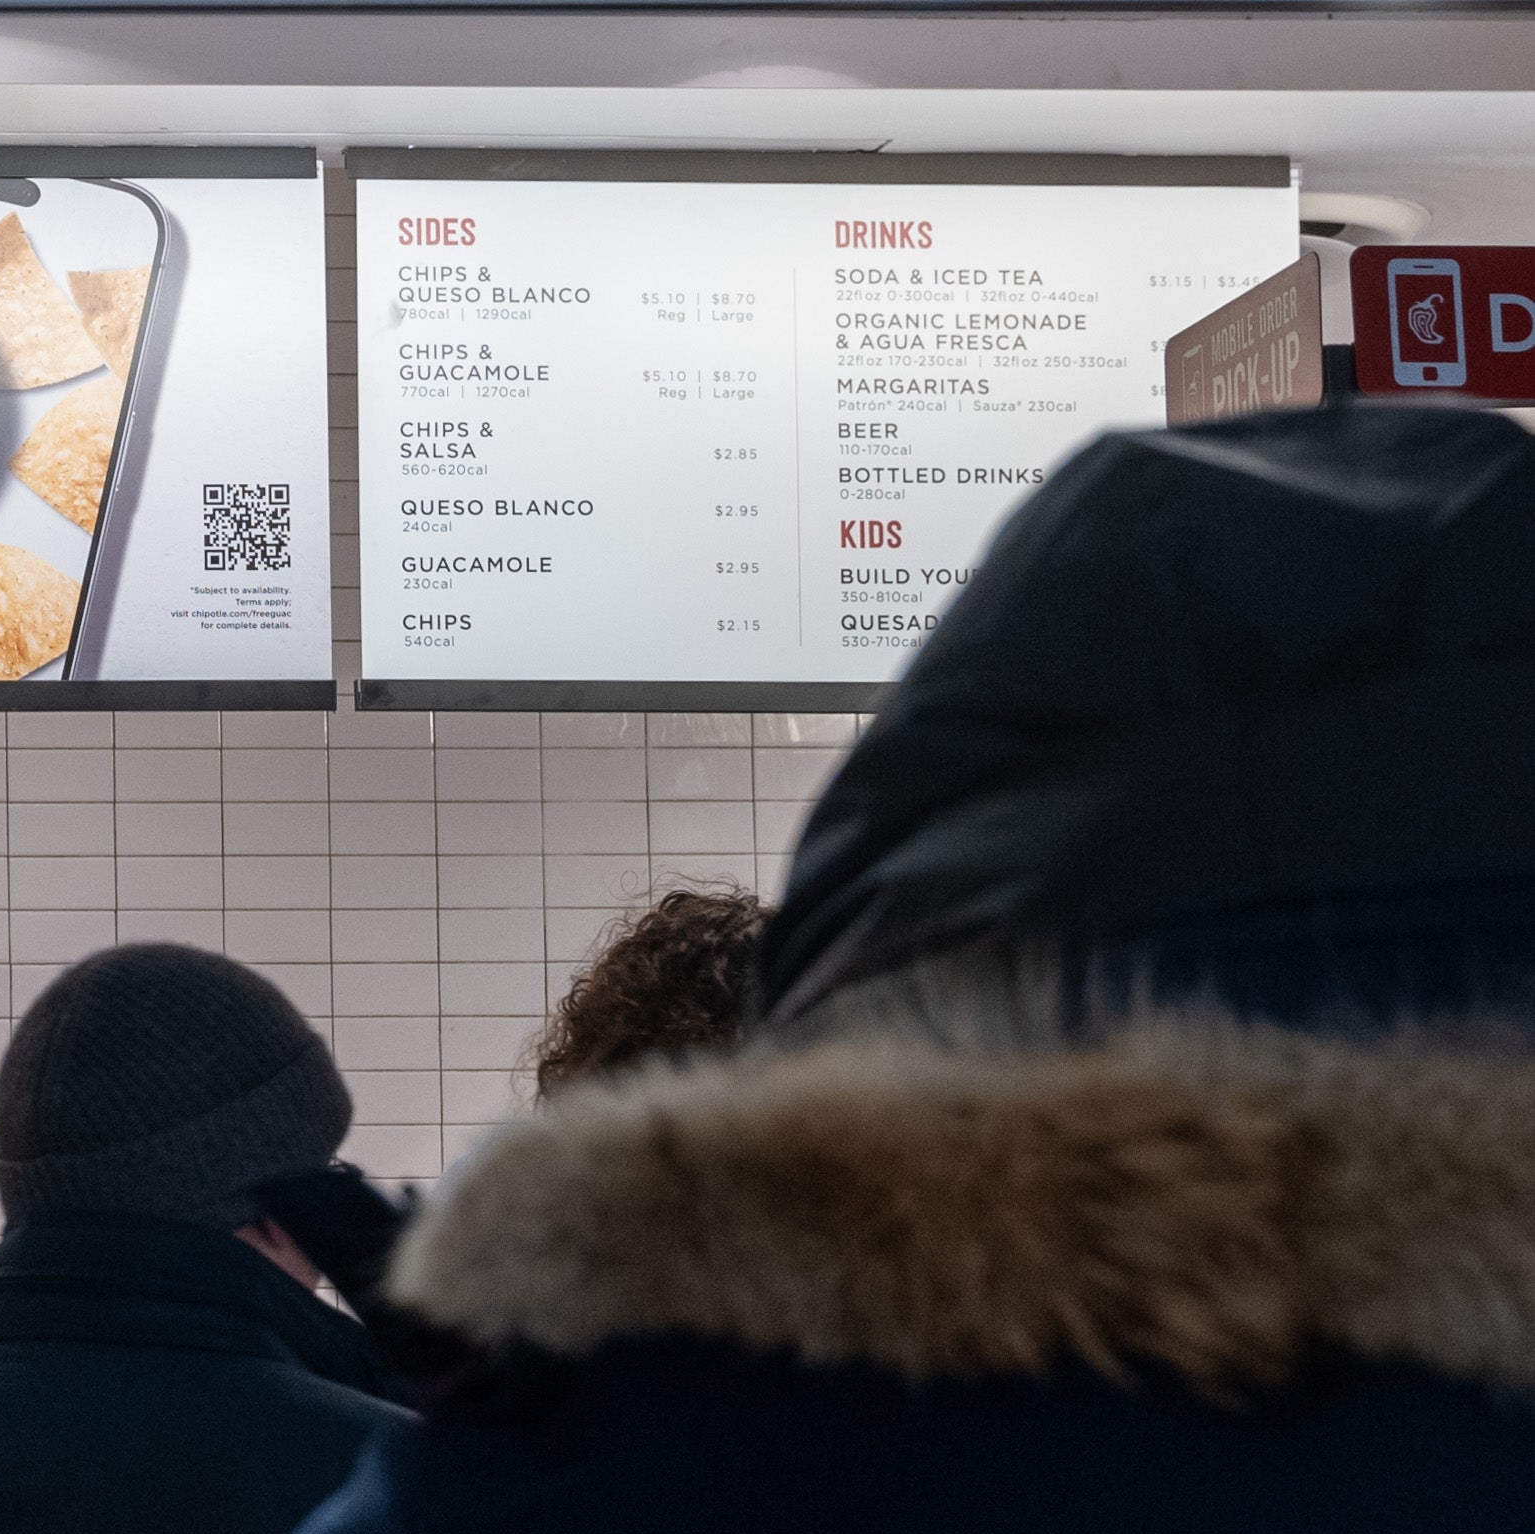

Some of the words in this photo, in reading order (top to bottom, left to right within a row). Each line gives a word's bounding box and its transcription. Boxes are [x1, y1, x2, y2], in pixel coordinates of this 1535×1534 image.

[399, 218, 475, 246] SIDES
[835, 221, 932, 249] DRINKS
[399, 266, 467, 282] CHIPS
[478, 267, 491, 282] &
[835, 269, 899, 284] SODA
[910, 269, 922, 285] &
[934, 269, 987, 285] ICED
[999, 270, 1043, 285] TEA
[1149, 275, 1192, 287] $3.15
[399, 287, 481, 303] QUESO
[493, 288, 590, 303] BLANCO
[641, 293, 685, 305] $5.10
[712, 293, 755, 305] $8.70
[887, 290, 954, 302] 0-300cal
[1031, 291, 1098, 303] 0-440cal
[401, 309, 450, 320] 780cal
[476, 309, 531, 320] 1290cal
[658, 309, 685, 323] Reg
[712, 310, 753, 323] Large
[836, 313, 944, 329] ORGANIC
[956, 314, 1086, 330] LEMONADE
[1211, 312, 1254, 366] MOBILE
[1260, 287, 1297, 337] ORDER
[836, 334, 848, 349] &
[860, 334, 925, 350] AGUA
[936, 335, 1027, 350] FRESCA
[399, 344, 468, 360] CHIPS
[479, 344, 492, 360] &
[889, 355, 967, 367] 170-230cal
[1044, 356, 1127, 368] 250-330cal
[400, 365, 549, 381] GUACAMOLE
[643, 370, 686, 382] $5.10
[713, 371, 756, 382] $8.70
[401, 386, 449, 397] 770cal
[477, 386, 529, 398] 1270cal
[659, 387, 686, 400] Reg
[713, 388, 754, 400] Large
[838, 379, 989, 395] MARGARITAS
[898, 400, 947, 411] 240cal
[1028, 401, 1076, 412] 230cal
[400, 422, 469, 437] CHIPS
[480, 422, 493, 437] &
[838, 423, 897, 438] BEER
[401, 443, 476, 458] SALSA
[714, 448, 757, 460] $2.85
[840, 444, 912, 456] 110-170cal
[402, 464, 487, 475] 560-620cal
[839, 468, 946, 483] BOTTLED
[957, 468, 1044, 484] DRINKS
[840, 488, 905, 500] 0-280cal
[401, 500, 483, 515] QUESO
[495, 500, 593, 516] BLANCO
[715, 505, 758, 517] $2.95
[403, 521, 452, 532] 240cal
[841, 520, 902, 548] KIDS
[402, 557, 552, 572] GUACAMOLE
[716, 562, 759, 574] $2.95
[841, 569, 910, 584] BUILD
[403, 578, 452, 589] 230cal
[242, 587, 290, 595] availability.
[842, 591, 922, 602] 350-810cal
[236, 598, 262, 606] Terms
[192, 610, 291, 619] chipotle.com/freeguac
[216, 622, 257, 630] complete
[403, 614, 471, 630] CHIPS
[717, 619, 760, 632] $2.15
[405, 636, 454, 647] 540cal
[842, 636, 921, 647] 530-710cal
